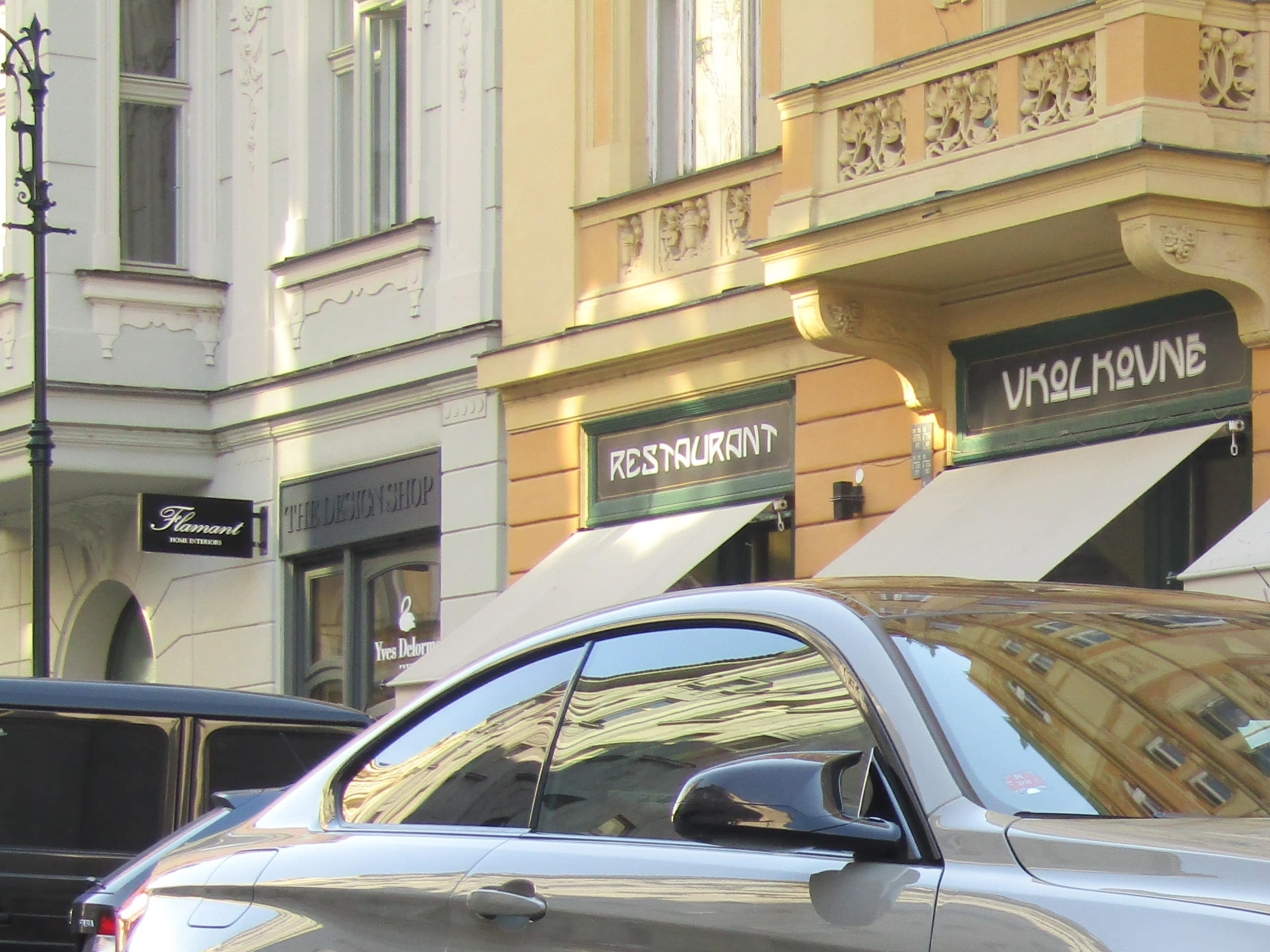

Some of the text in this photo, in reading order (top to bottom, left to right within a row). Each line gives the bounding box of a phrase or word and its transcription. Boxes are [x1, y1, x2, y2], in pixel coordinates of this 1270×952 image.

[610, 423, 778, 482] RESTAURANT
[284, 475, 434, 534] THE DESIGN SHOP
[150, 505, 245, 536] Flamant
[189, 538, 223, 546] INTERIORS
[374, 640, 397, 662] Yves
